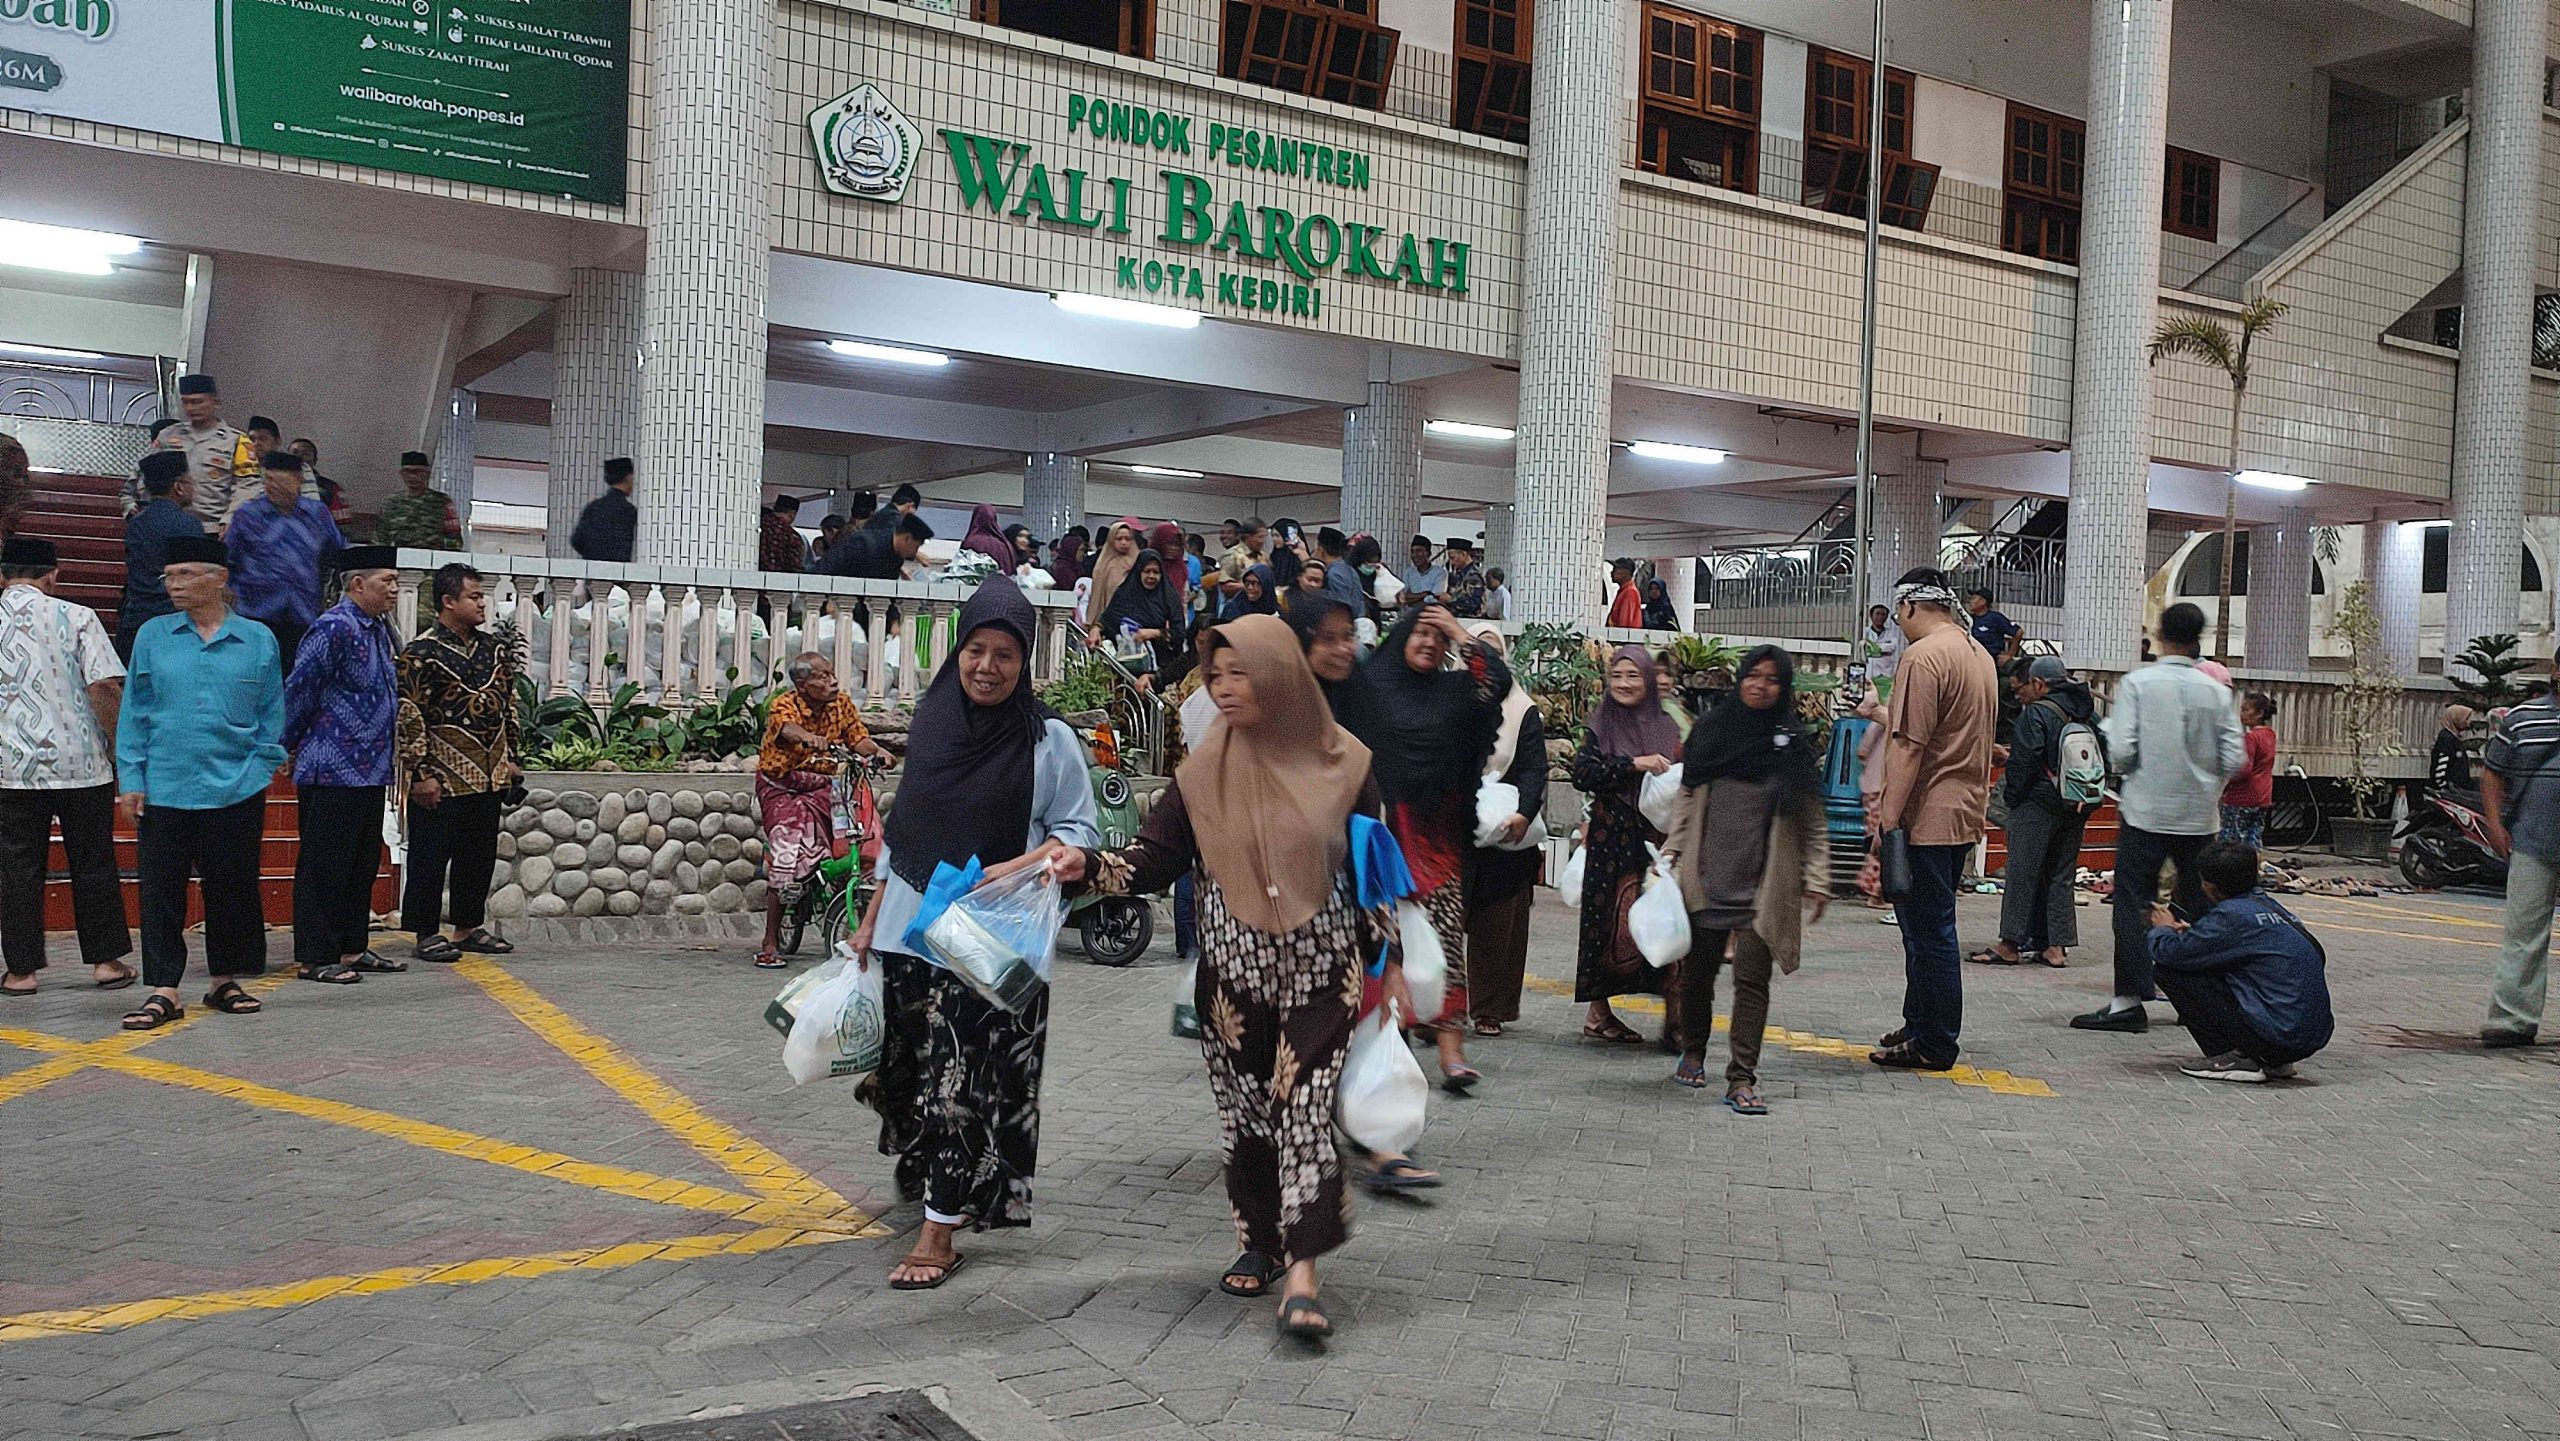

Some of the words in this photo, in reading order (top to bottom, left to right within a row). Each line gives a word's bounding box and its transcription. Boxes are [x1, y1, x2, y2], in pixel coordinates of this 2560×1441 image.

[290, 0, 346, 17] TADARUS
[348, 10, 363, 21] AL
[365, 13, 409, 29] QURAN
[474, 13, 516, 30] SUKSES
[517, 22, 559, 39] SHALAT
[381, 39, 425, 57] SUKSES
[427, 49, 465, 64] ZAKAT
[573, 54, 614, 69] QODAR
[0, 59, 46, 83] 6M
[339, 84, 525, 127] walibarokah.ponpes.id
[1069, 94, 1190, 154] PONDOK
[1210, 122, 1370, 189] PESANTREN
[938, 128, 1132, 234] WALI
[1160, 171, 1472, 294] BAROKAH
[1118, 256, 1205, 300] KOTA
[1218, 272, 1321, 318] KEDIRI
